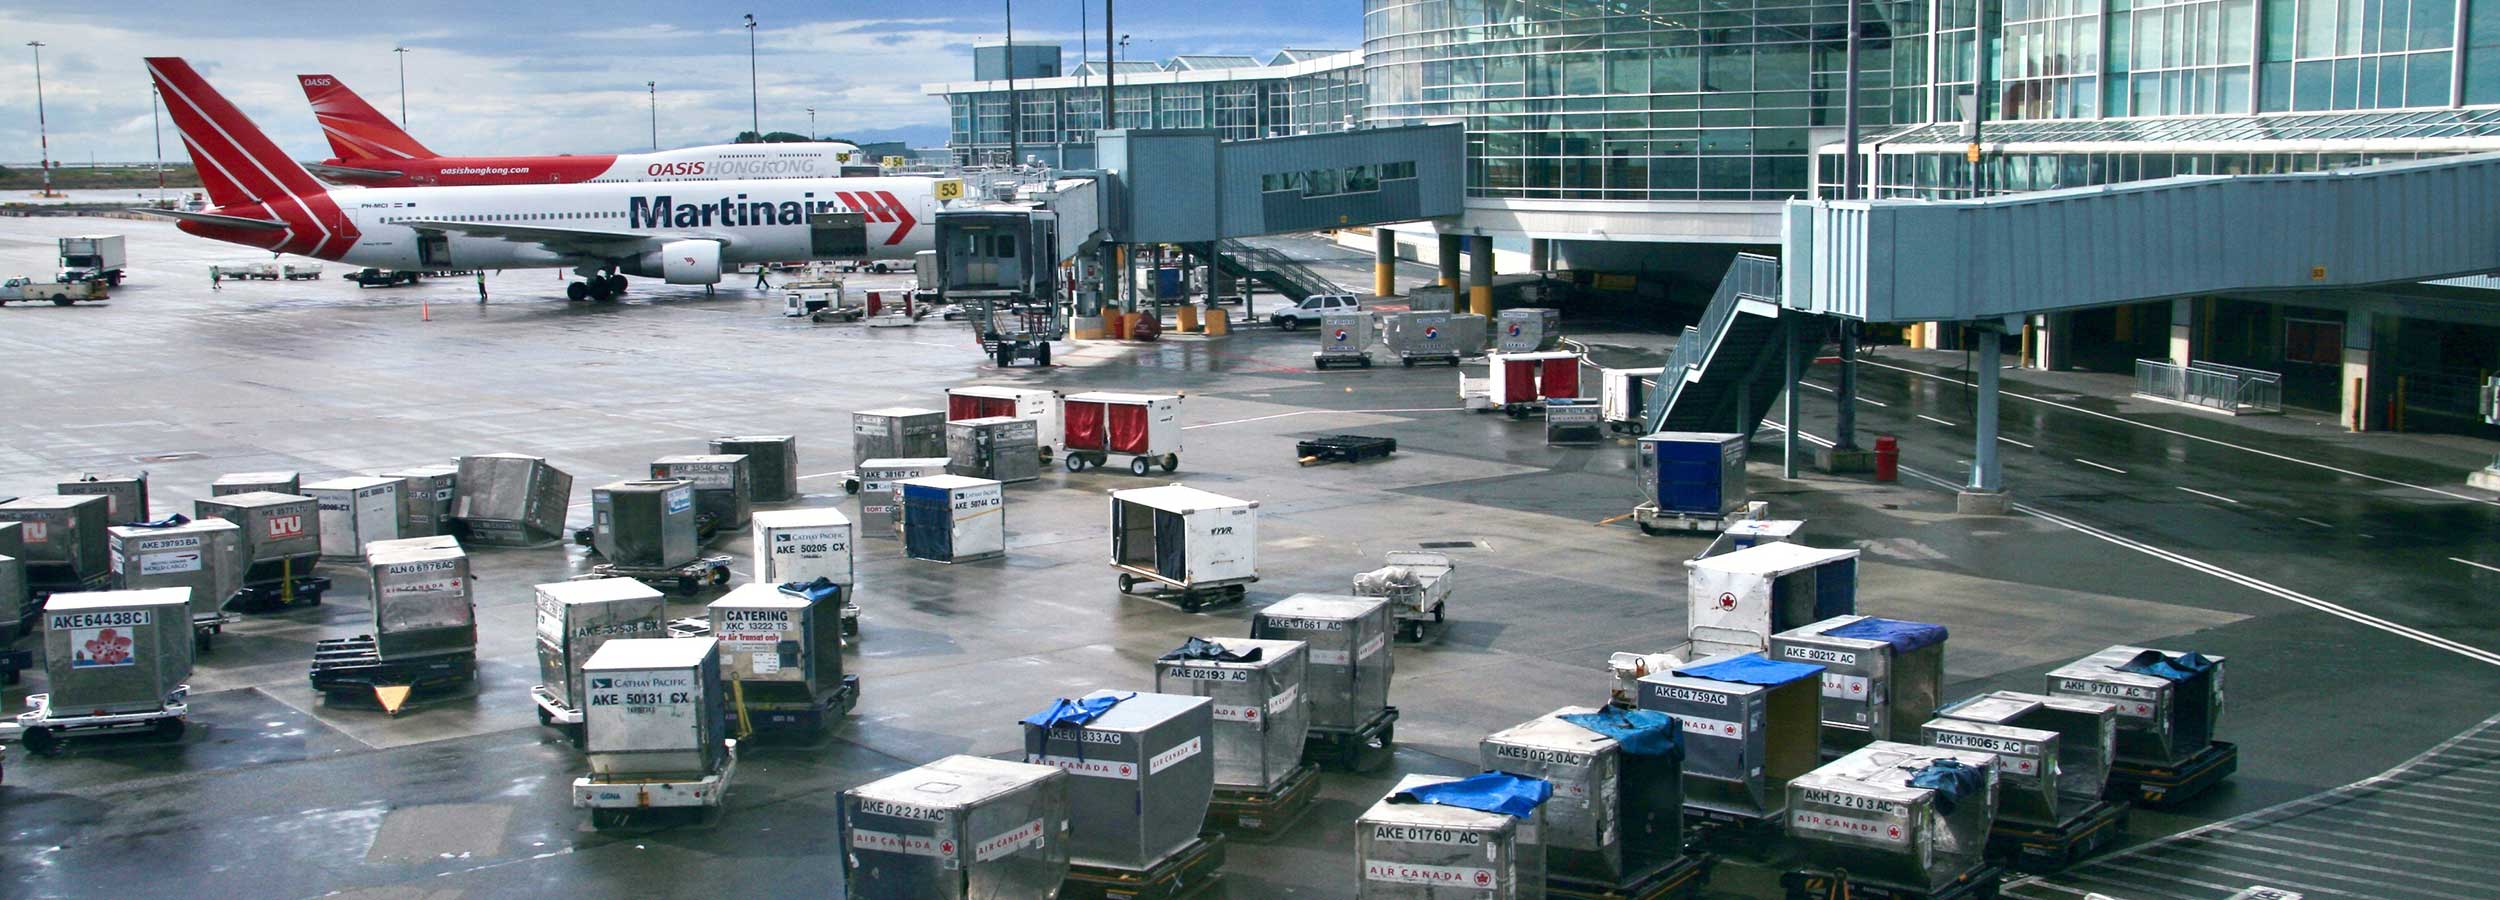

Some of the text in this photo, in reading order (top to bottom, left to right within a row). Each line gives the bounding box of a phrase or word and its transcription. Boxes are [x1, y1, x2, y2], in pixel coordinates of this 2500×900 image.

[304, 78, 331, 87] OASIS
[440, 166, 529, 176] oasishongkong.com
[706, 159, 815, 175] HONGKONG
[941, 182, 958, 197] 53
[910, 470, 920, 478] CX
[955, 502, 968, 510] AKE
[991, 498, 1000, 506] CX
[270, 516, 302, 535] LTU
[141, 541, 159, 549] AKE
[776, 543, 845, 554] AKE 50205 CX
[727, 610, 788, 622] CATERING
[578, 627, 601, 637] AKE
[644, 621, 658, 631] CX
[726, 622, 788, 631] XKC 13222 TS
[1270, 618, 1341, 630] AKE 01661 AC
[728, 633, 737, 641] Air
[738, 633, 763, 641] Transat
[765, 633, 779, 643] only
[1785, 647, 1854, 664] AKE 90212 AC
[1171, 667, 1246, 681] AKE 02193 AC
[614, 677, 688, 688] CATHAY PACIFIC
[2064, 680, 2140, 697] AKH 9700 AC
[592, 692, 689, 706] AKE 50131 CX
[1684, 720, 1715, 732] NADA
[1938, 732, 2020, 753] AKH 10065 AC
[1164, 747, 1189, 764] CANADA
[1060, 760, 1109, 772] CANADA
[1797, 814, 1878, 833] AIR CANADA
[856, 834, 931, 850] AIR CANADA
[978, 829, 1029, 856] AIR CANADA
[1376, 827, 1479, 844] AKE 01760 AC
[1370, 866, 1463, 881] AIR CANADA
